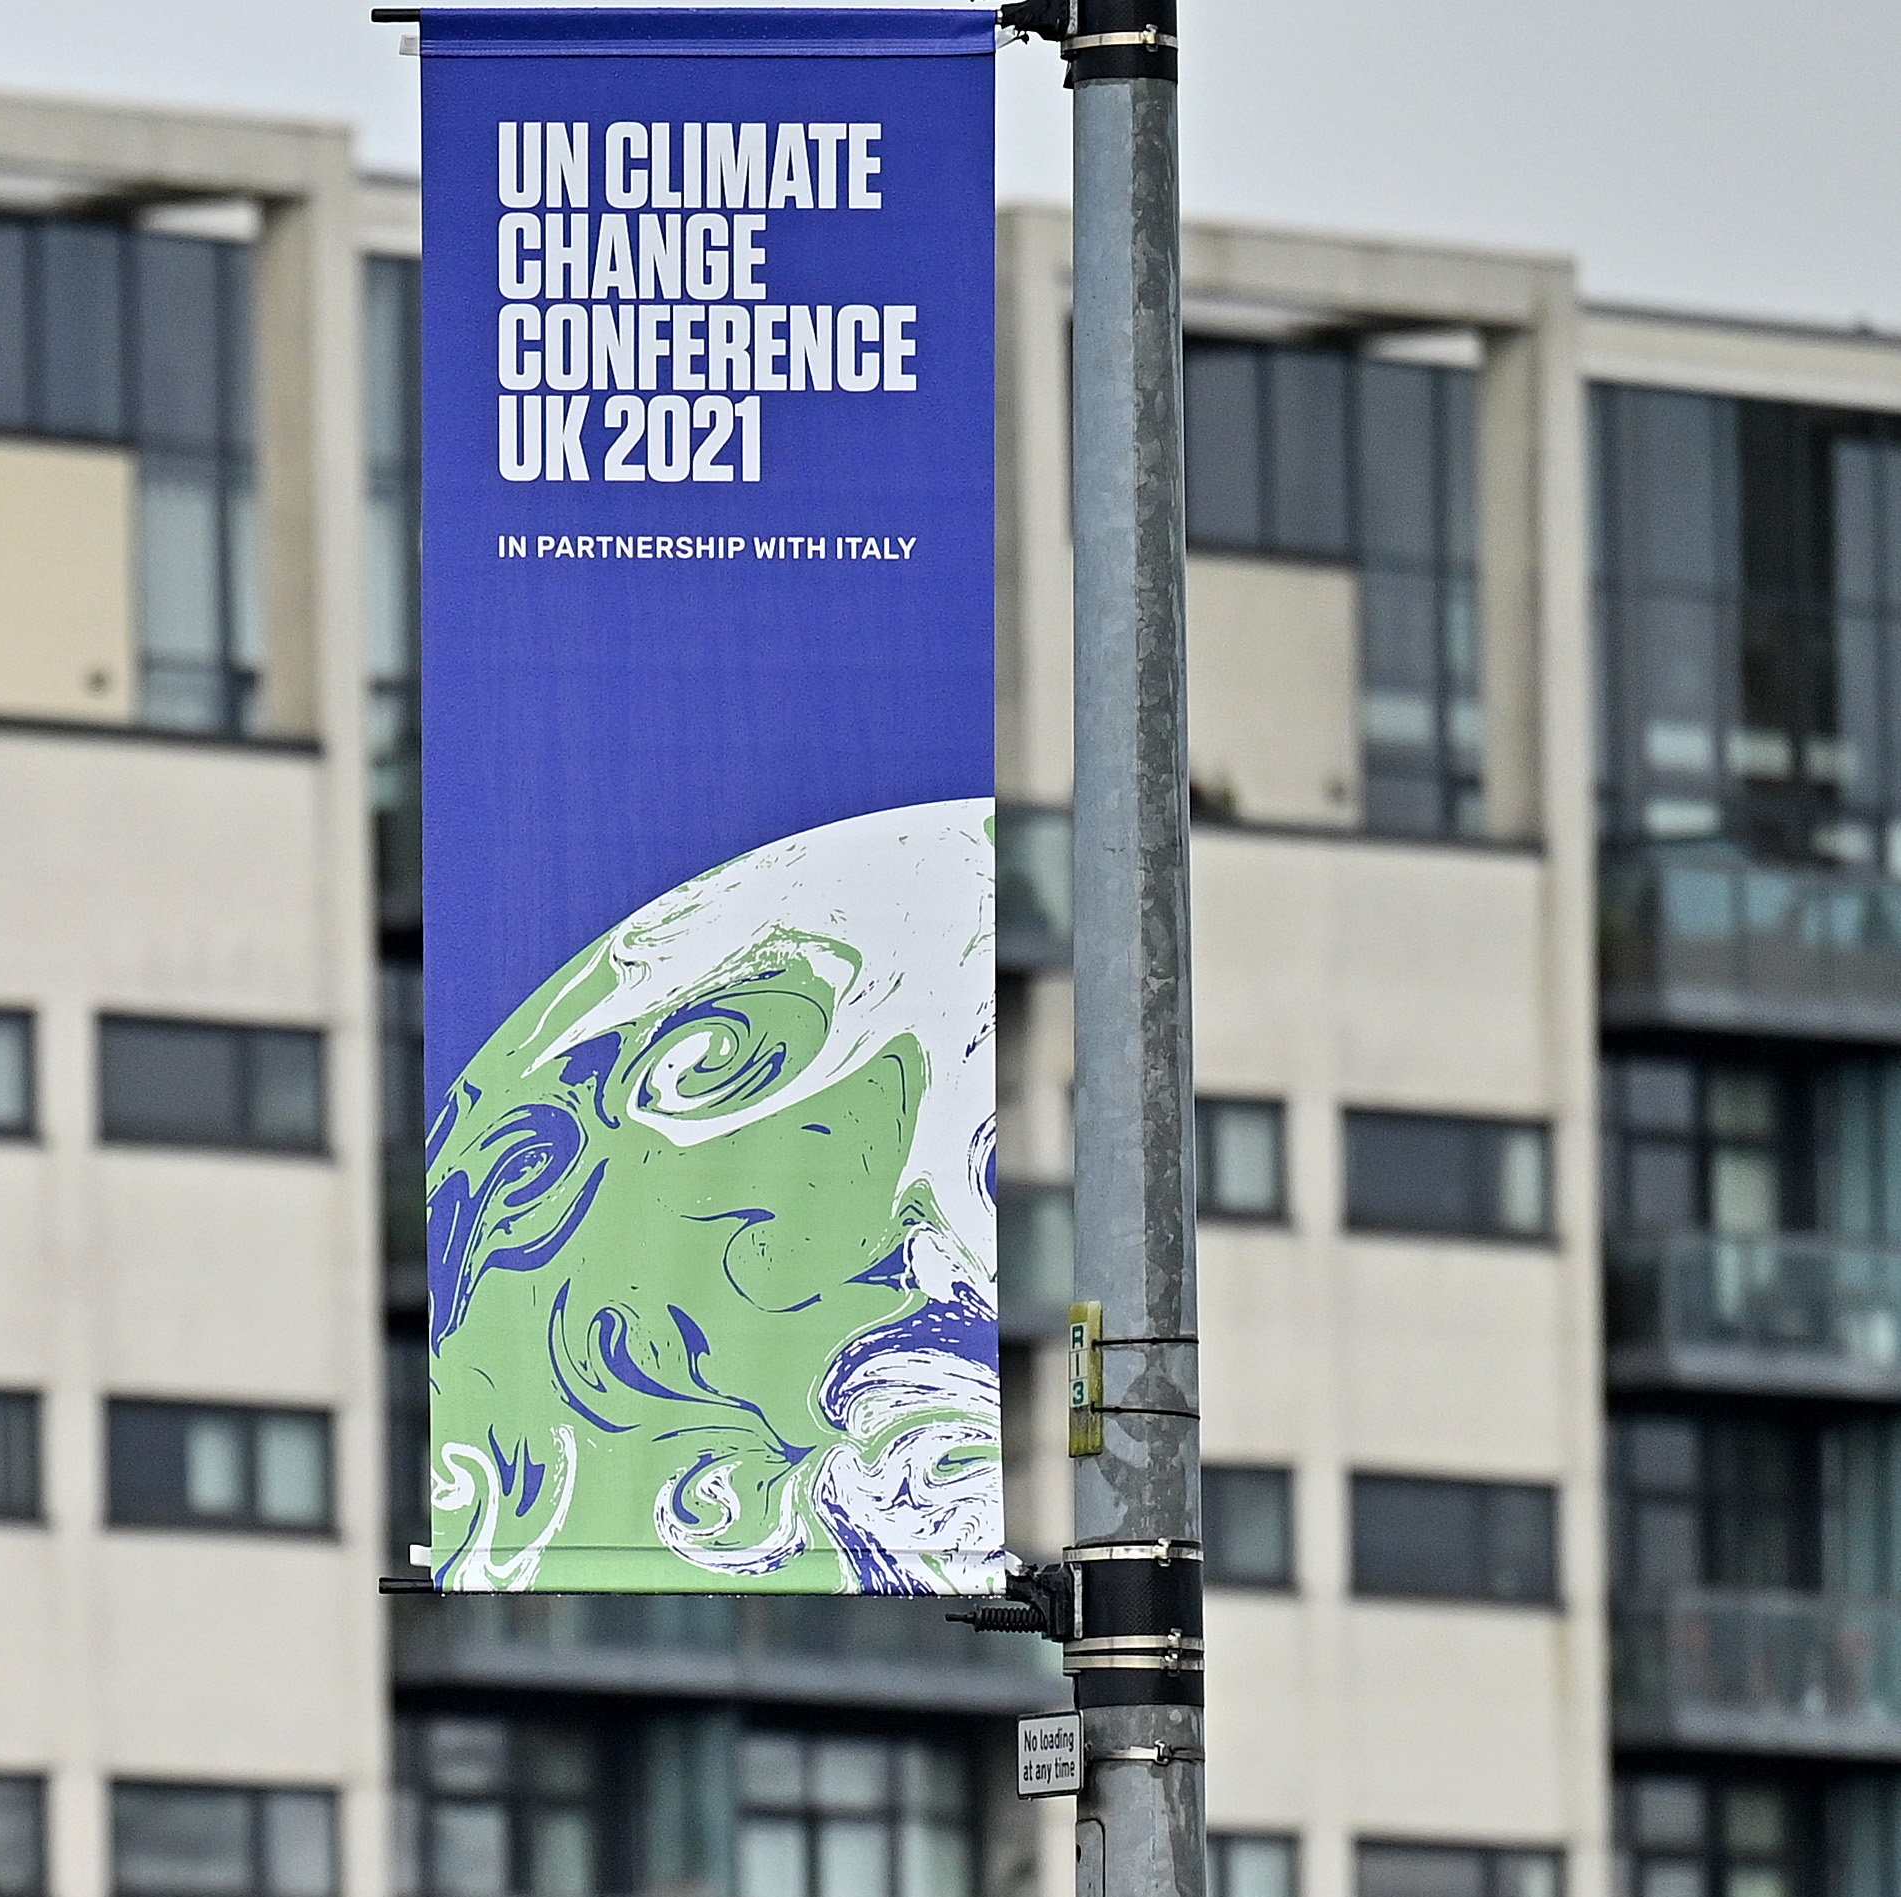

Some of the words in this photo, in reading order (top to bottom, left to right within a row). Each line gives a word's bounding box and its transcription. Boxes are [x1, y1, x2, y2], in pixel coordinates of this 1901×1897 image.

[498, 121, 589, 208] UN
[604, 121, 882, 209] CLIMATE
[498, 213, 766, 300] CHANGE
[498, 303, 917, 392] CONFERENCE
[498, 395, 590, 482] UK
[603, 395, 761, 482] 2021
[497, 535, 527, 559] IN
[536, 535, 746, 560] PARTNERSHIP
[753, 536, 826, 560] WITH
[835, 536, 917, 560] ITALY
[1023, 1760, 1033, 1781] at
[1035, 1763, 1052, 1784] any
[1055, 1757, 1075, 1778] time
[1024, 1730, 1038, 1752] No
[1040, 1727, 1074, 1752] loading
